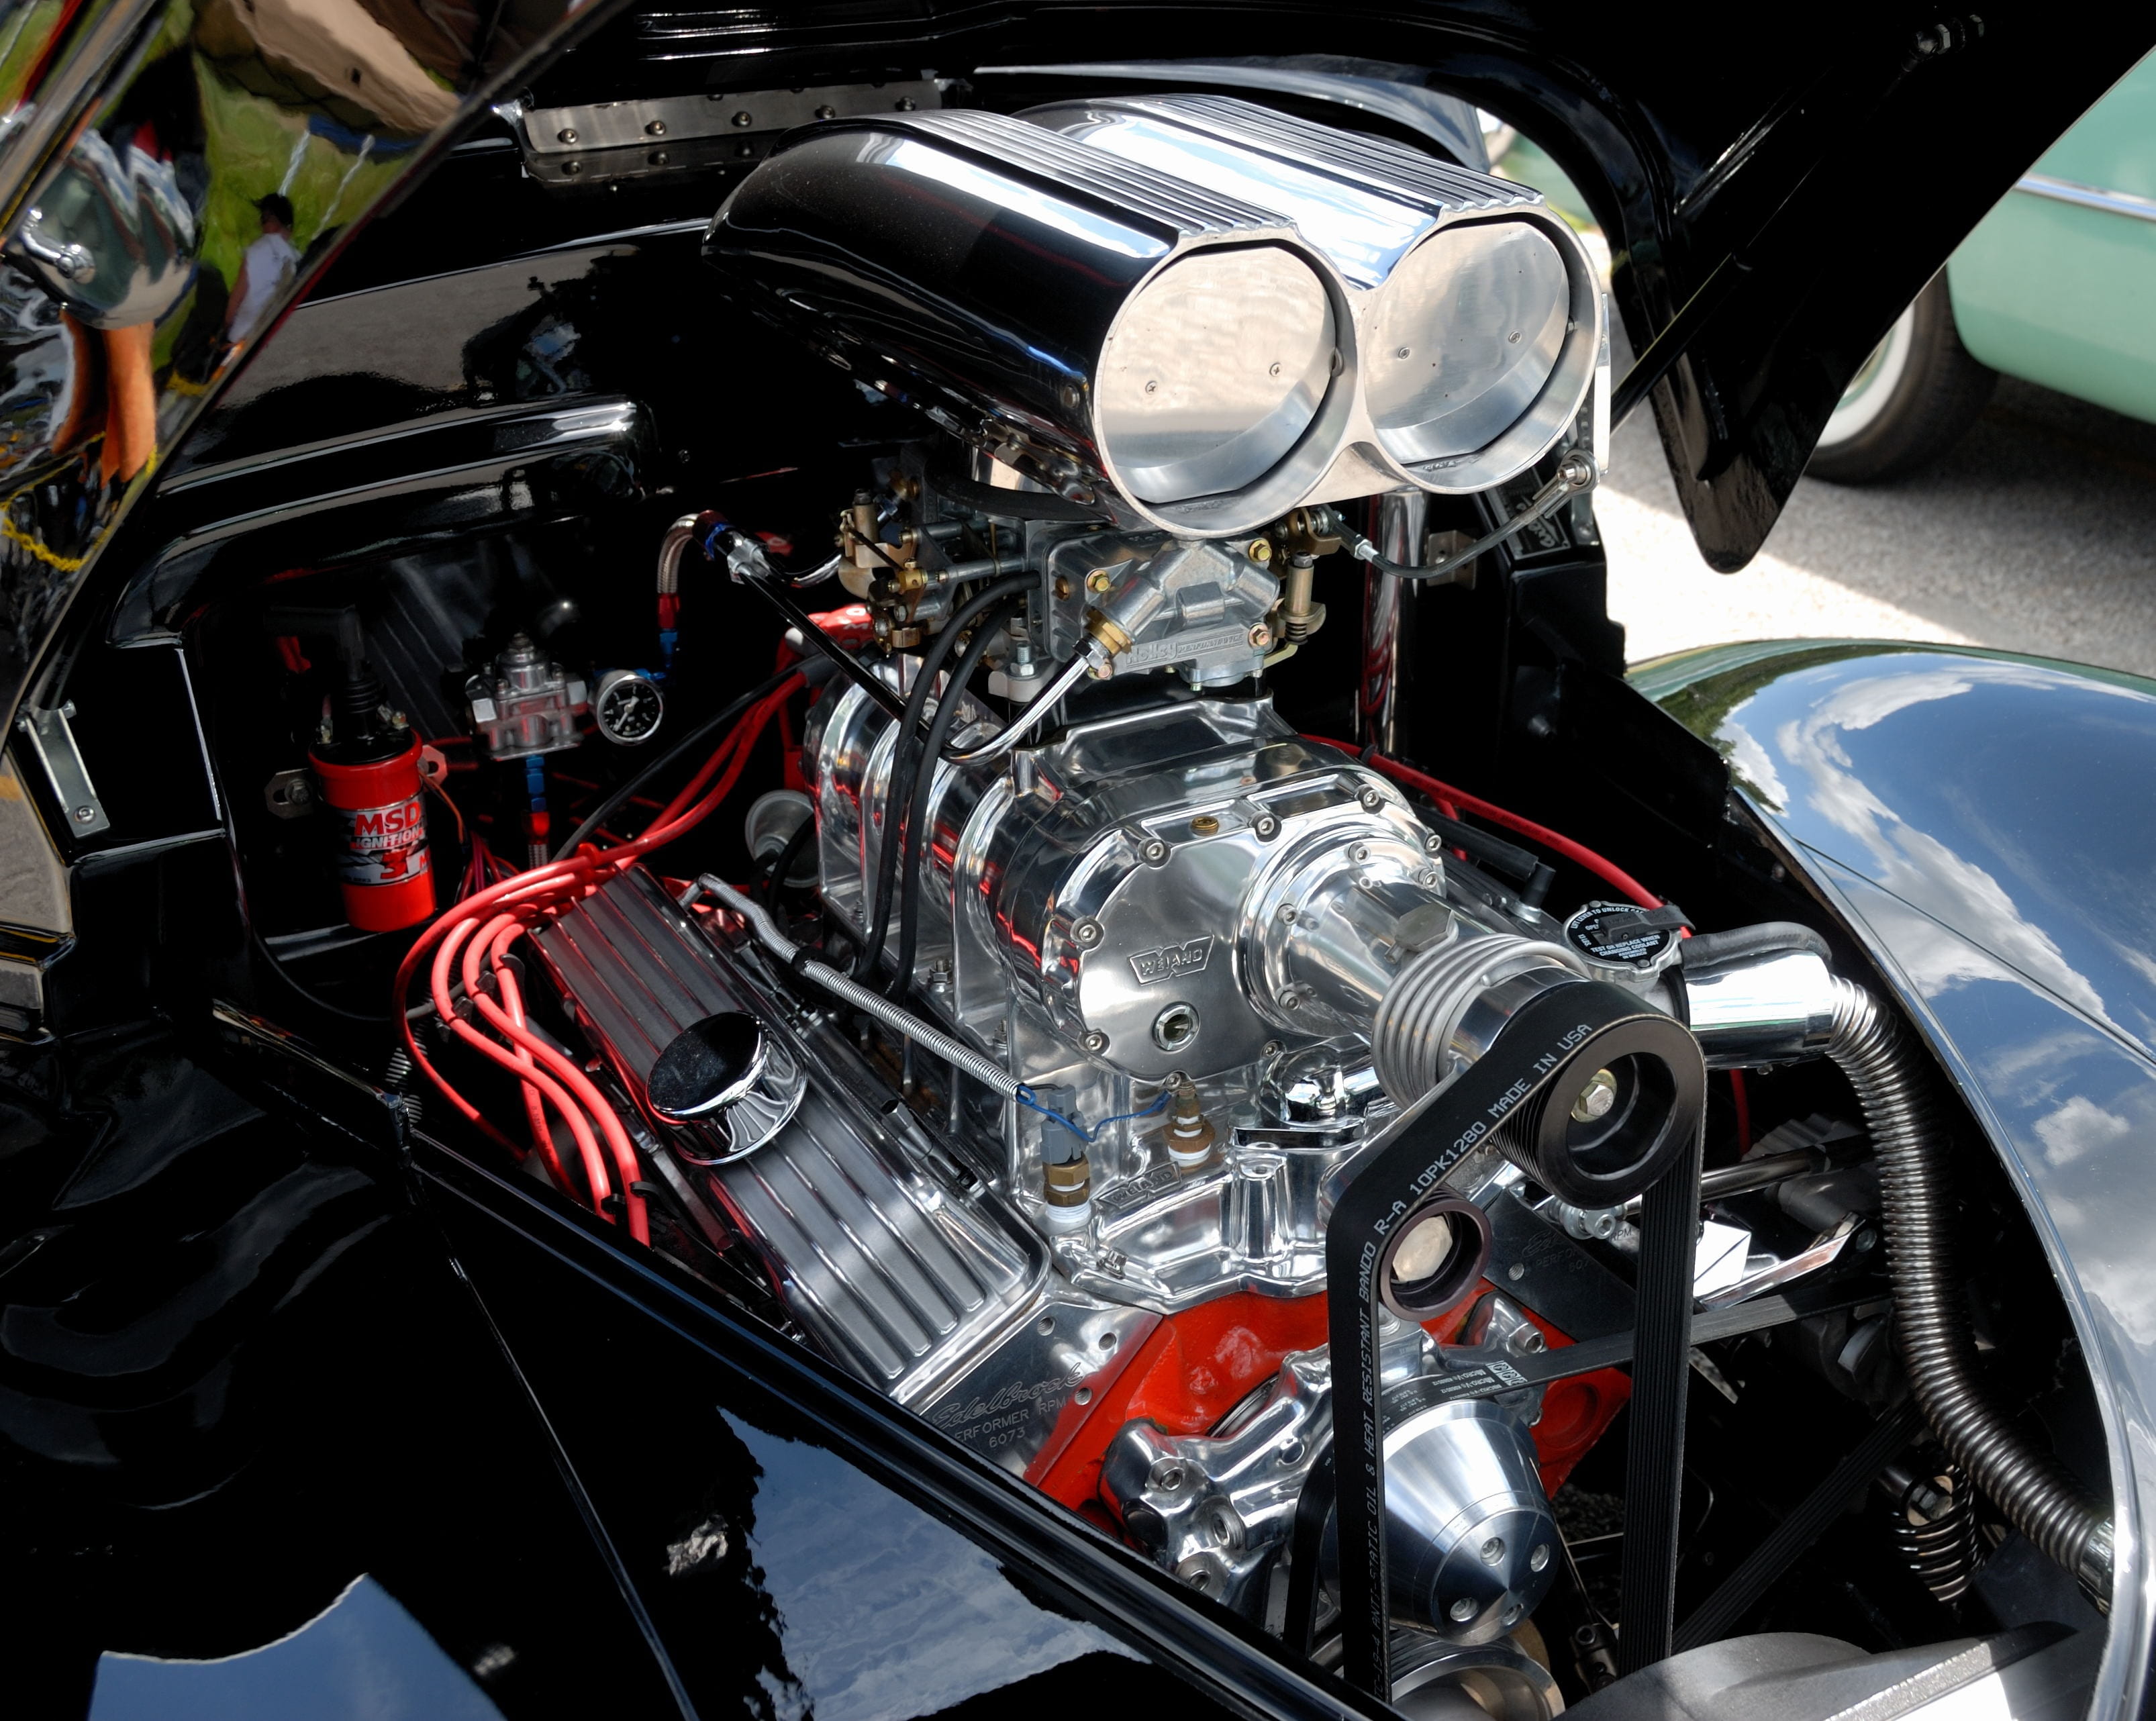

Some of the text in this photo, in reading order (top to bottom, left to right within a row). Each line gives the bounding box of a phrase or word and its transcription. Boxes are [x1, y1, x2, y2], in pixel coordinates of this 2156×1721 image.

[354, 801, 421, 837] MSD
[356, 826, 420, 849] IGNITION
[1579, 912, 1593, 922] LEVER
[1590, 945, 1606, 953] TEST
[1615, 939, 1640, 948] REPLACE
[1640, 934, 1661, 944] WHEN
[1599, 940, 1659, 956] CHANGING COOLANT
[1141, 948, 1204, 976] WEIAND
[1557, 1024, 1594, 1052] USA
[1532, 1053, 1558, 1075] IN
[1487, 1078, 1532, 1119] MADE
[1410, 1121, 1487, 1196] 10PK1280
[1373, 1199, 1408, 1236] R-A
[1359, 1241, 1376, 1304] BANDO
[1359, 1308, 1373, 1408] RESISTANT
[932, 1362, 1084, 1430] Edelbrock
[954, 1396, 1069, 1442] ERFORMER RPM
[1363, 1410, 1375, 1458] HEAT
[989, 1427, 1026, 1448] 6073
[1365, 1463, 1375, 1477] &
[1365, 1486, 1377, 1516] OIL
